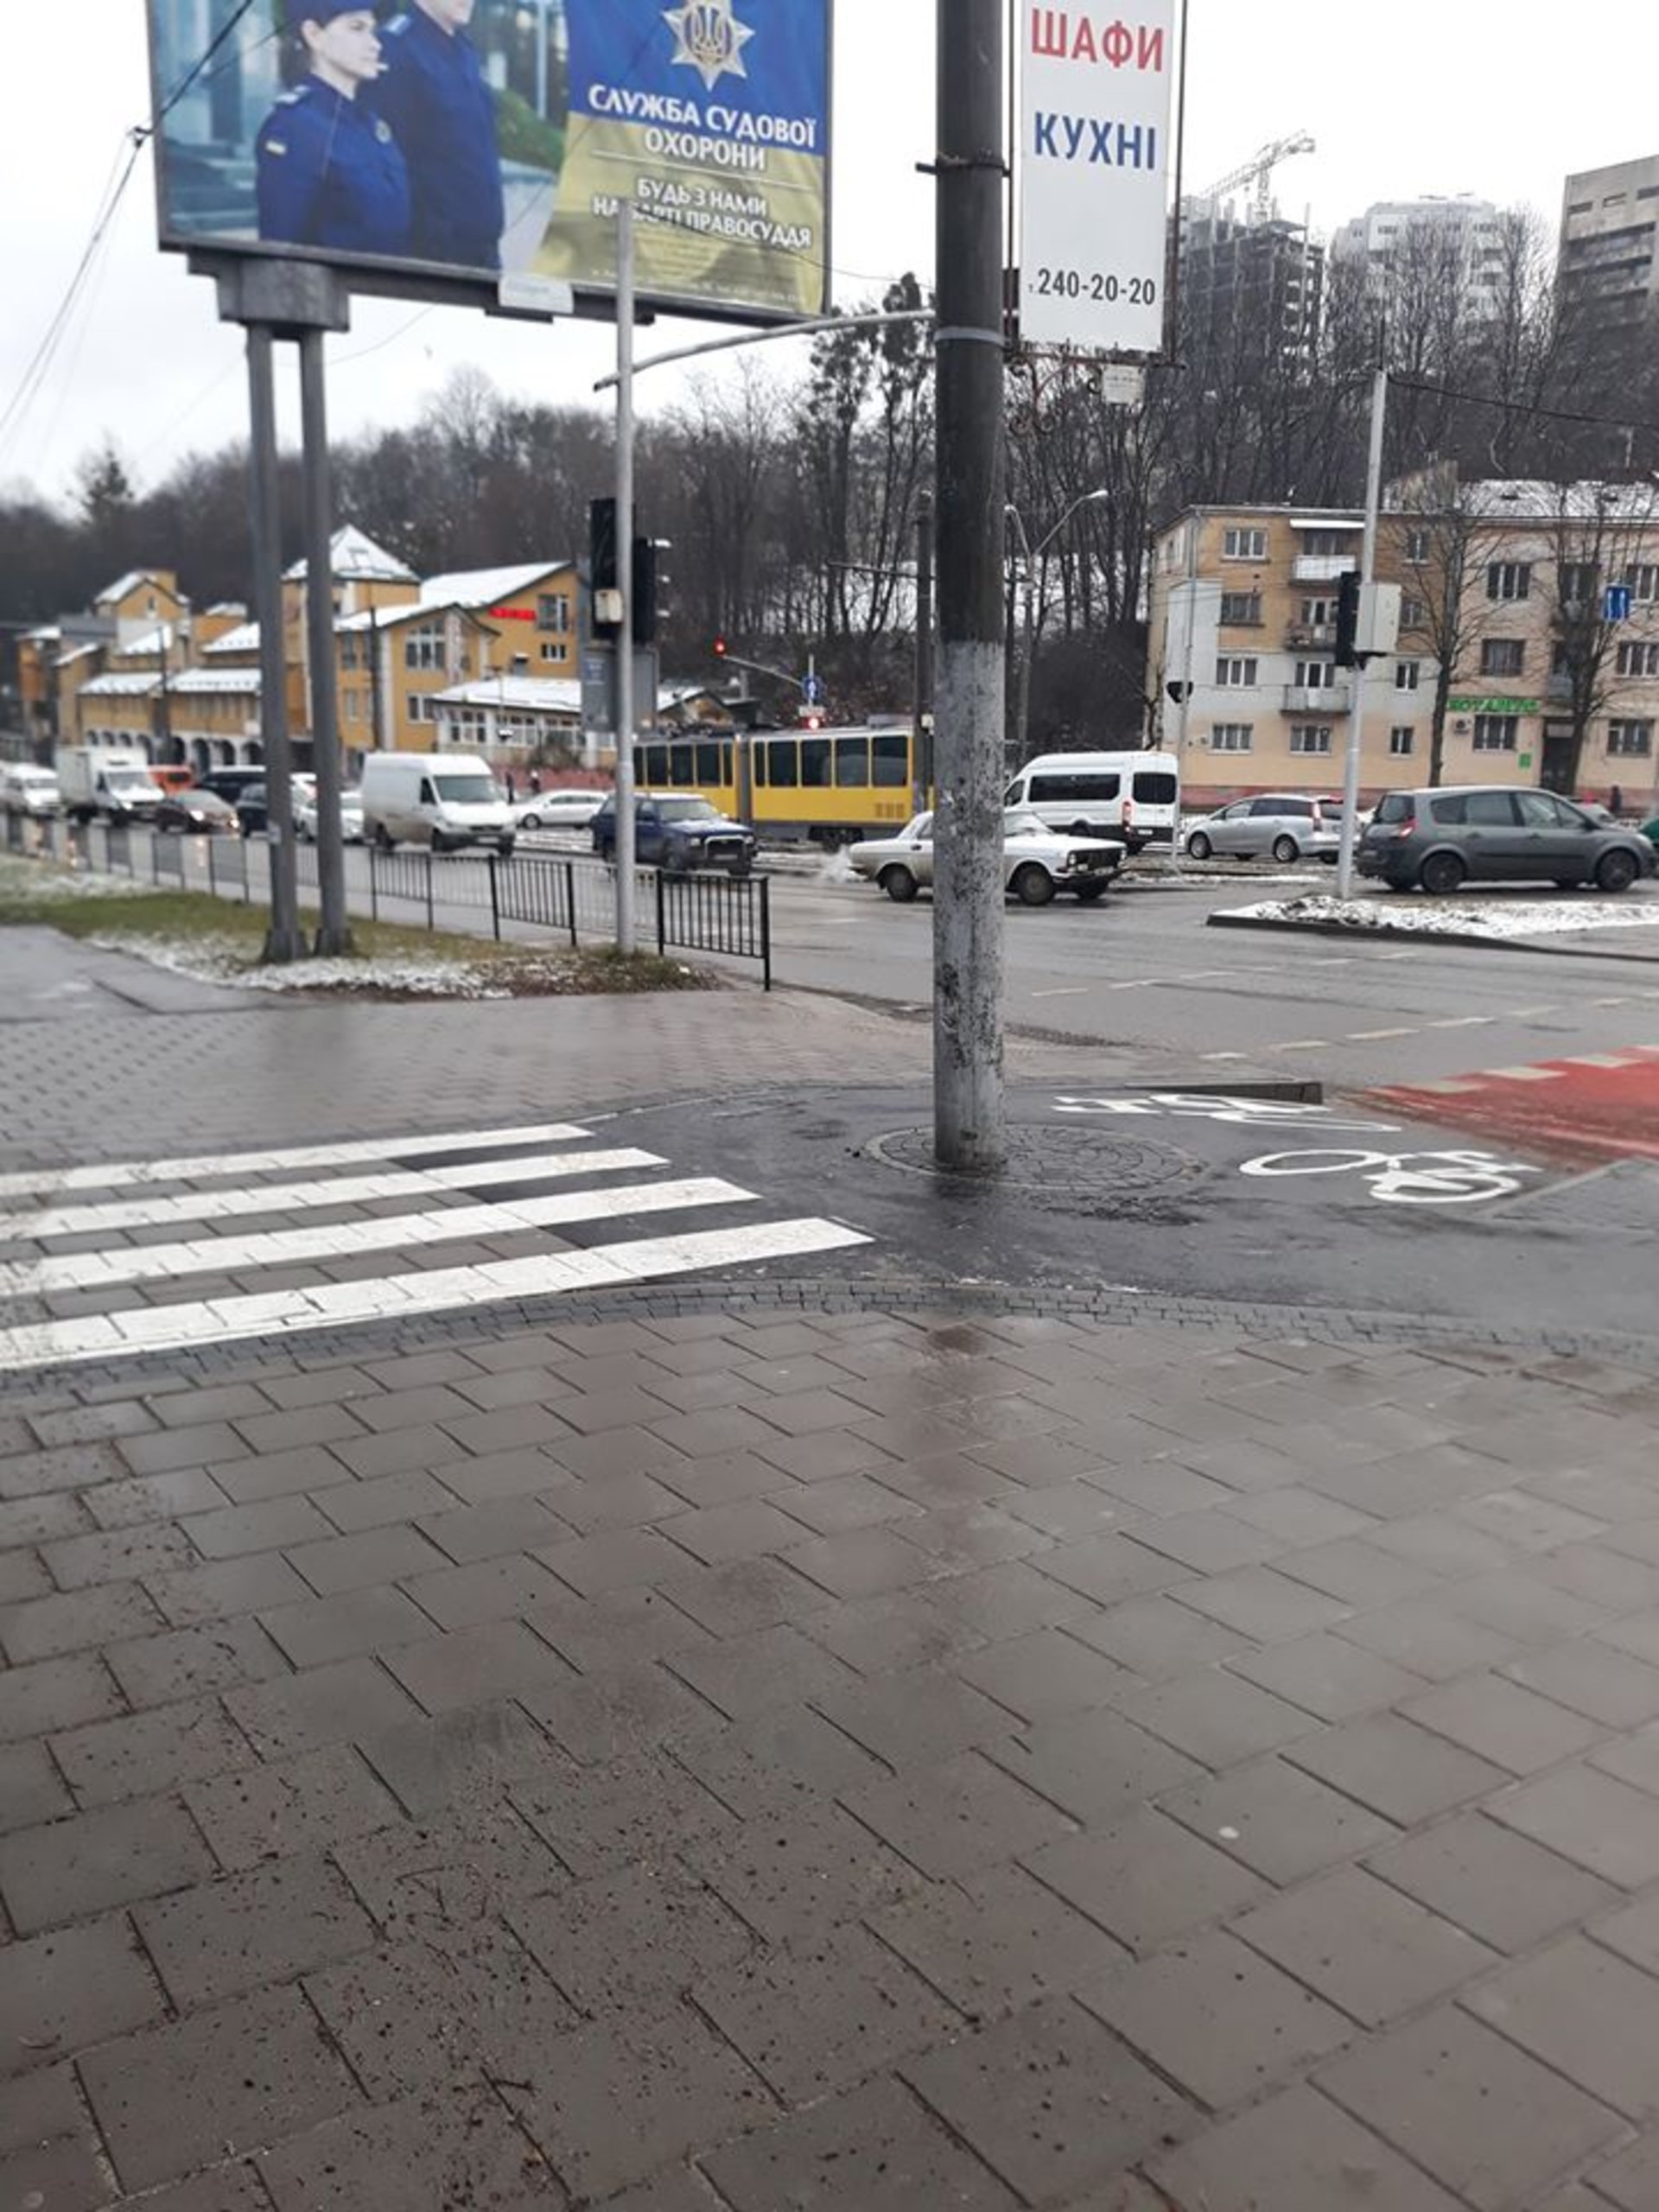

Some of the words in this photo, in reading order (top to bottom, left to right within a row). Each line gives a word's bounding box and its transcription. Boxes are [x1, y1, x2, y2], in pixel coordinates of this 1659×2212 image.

[1031, 9, 1164, 72] ШАФИ
[588, 85, 700, 127] СЛУЖБА
[706, 105, 817, 148] СУДОВОЇ
[1034, 111, 1156, 169] КУХНІ
[645, 128, 766, 170] ОХОРОНИ
[638, 178, 690, 205] БУДЬ
[710, 190, 766, 216] НАМИ
[684, 211, 812, 248] ПРАВОСУДДЯ
